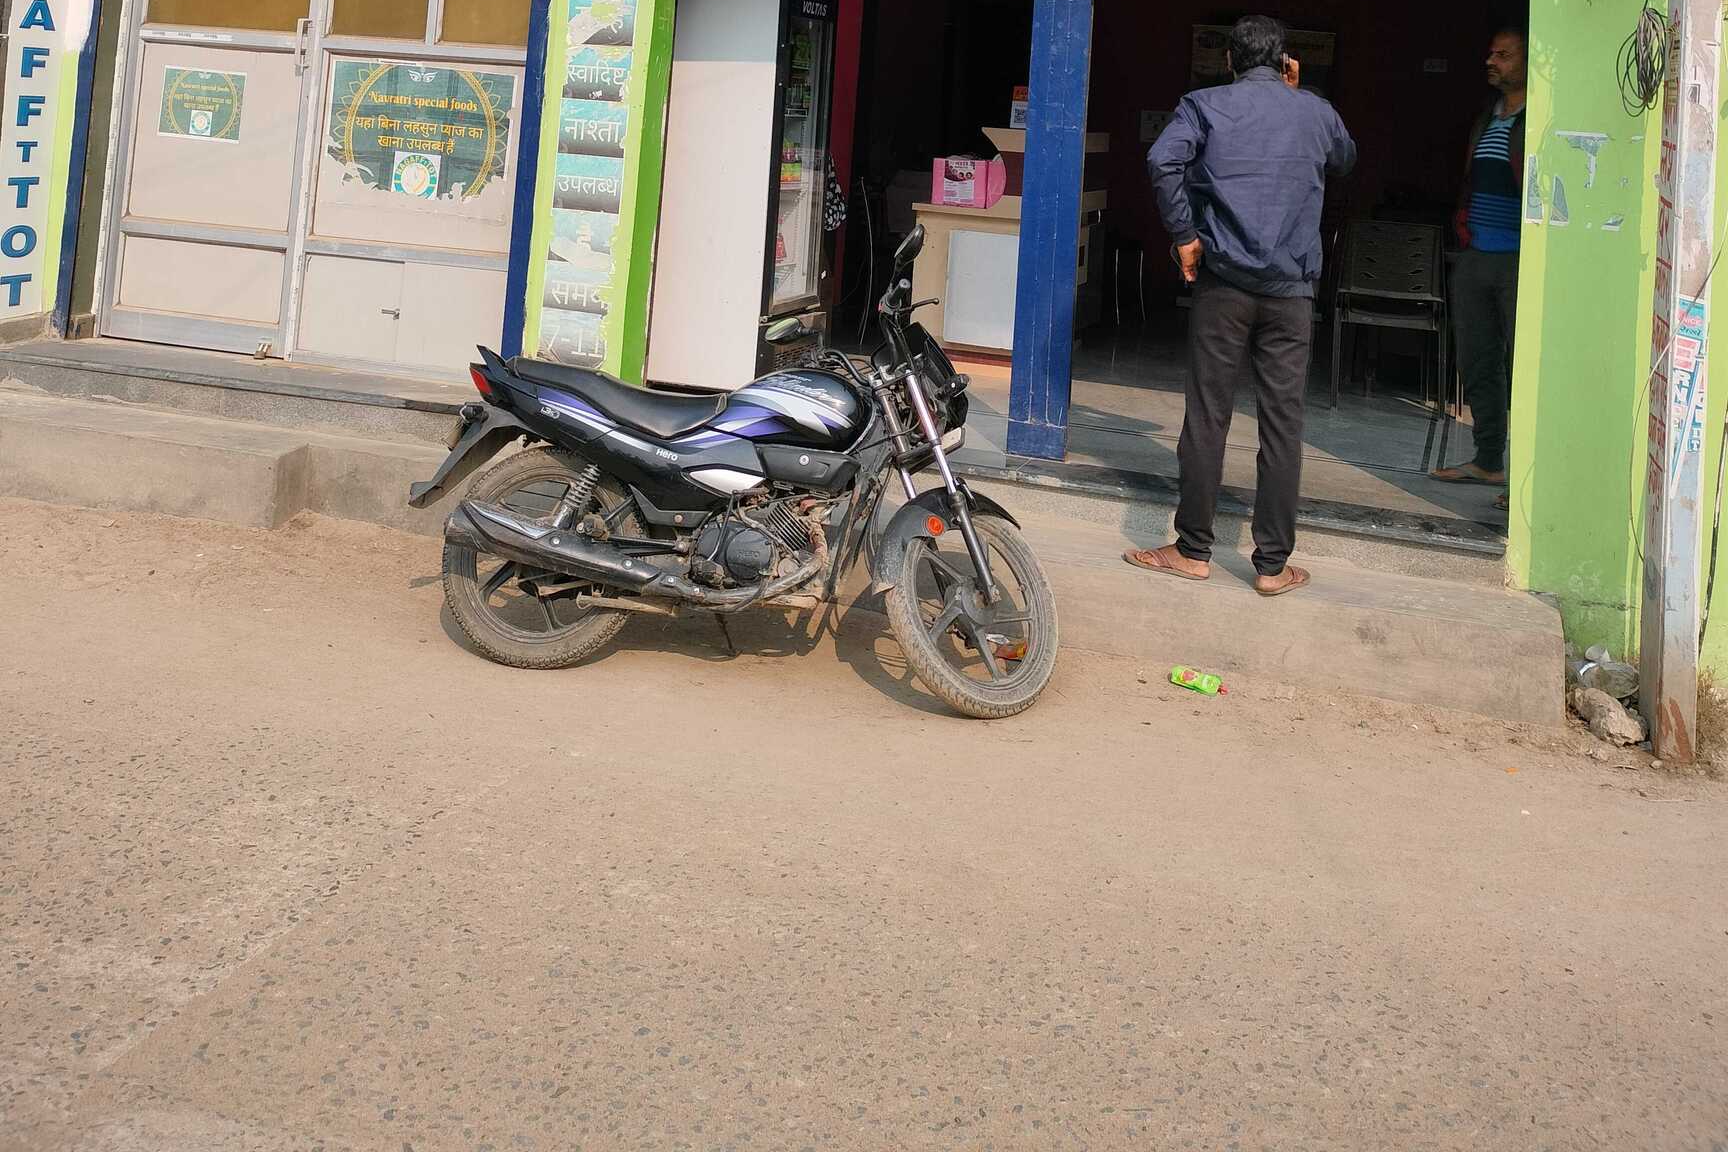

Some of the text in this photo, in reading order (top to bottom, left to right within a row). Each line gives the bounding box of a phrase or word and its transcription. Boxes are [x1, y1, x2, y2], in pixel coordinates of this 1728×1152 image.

[802, 0, 828, 17] VOLTAS
[414, 95, 449, 109] special
[450, 96, 479, 112] foods
[378, 113, 402, 132] बिना
[403, 119, 438, 138] लहसुन
[468, 126, 484, 140] का
[564, 117, 622, 144] नाश्ता
[378, 134, 403, 149] खाना
[557, 174, 620, 197] उपलब्ध
[656, 448, 679, 463] Hero
